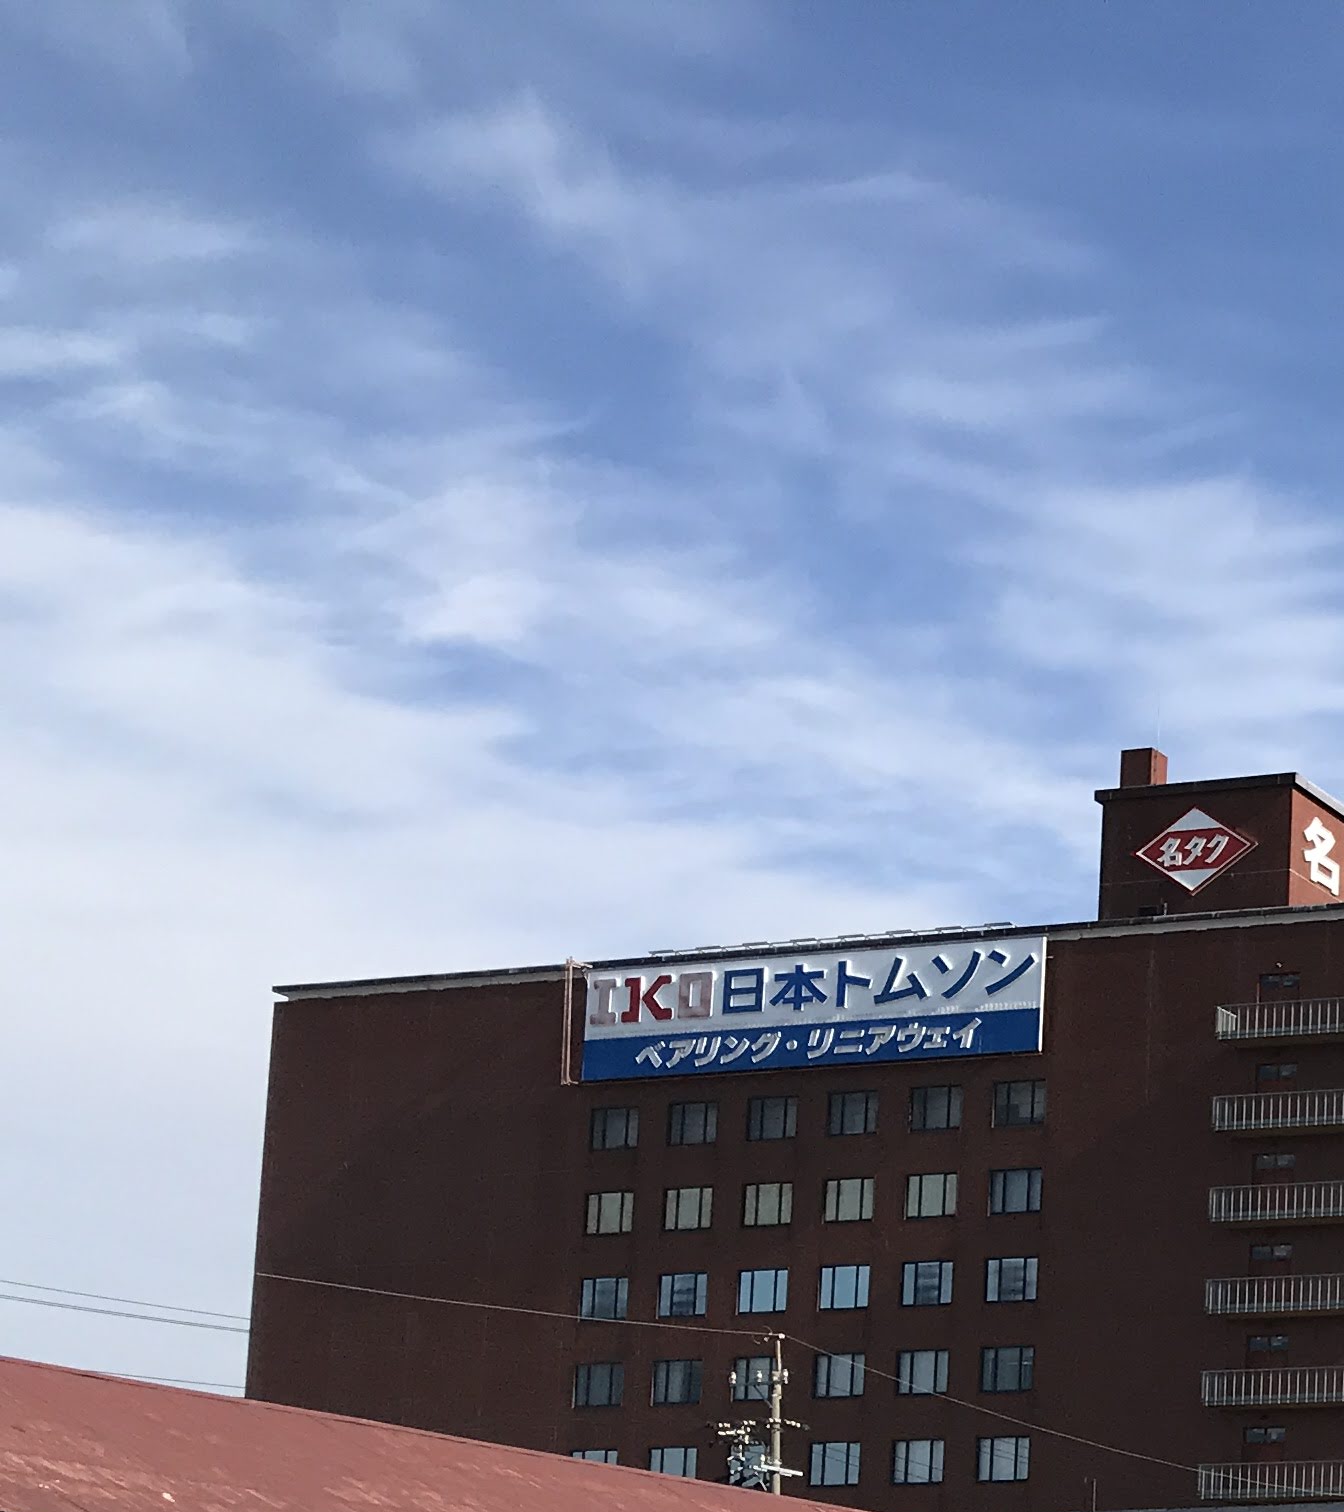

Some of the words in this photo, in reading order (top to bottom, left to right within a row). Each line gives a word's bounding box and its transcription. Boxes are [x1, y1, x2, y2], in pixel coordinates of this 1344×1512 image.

[1157, 833, 1229, 867] 名タク
[589, 971, 717, 1027] IKO
[721, 947, 1041, 1015] 日本トムソン
[634, 1016, 984, 1070] ベアリング・リニアウェイ
